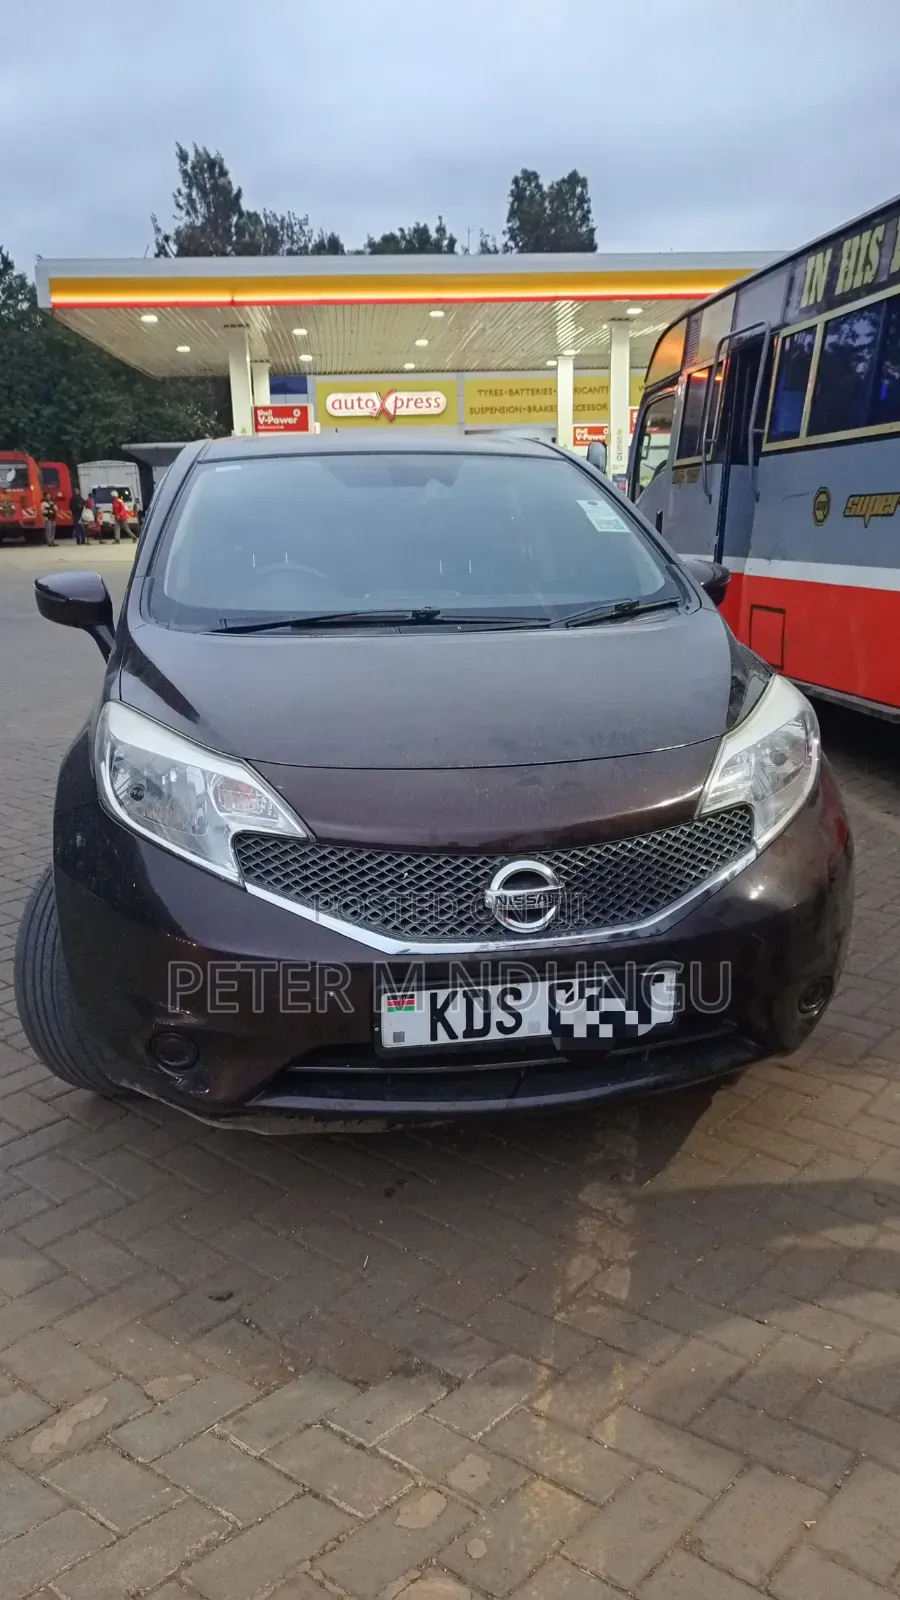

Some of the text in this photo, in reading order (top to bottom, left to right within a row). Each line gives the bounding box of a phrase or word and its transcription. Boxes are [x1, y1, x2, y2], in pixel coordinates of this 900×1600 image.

[800, 248, 833, 309] IN
[834, 223, 886, 296] HIS
[477, 389, 504, 397] TYRES
[508, 387, 553, 397] BATTERIES
[469, 405, 522, 415] SUSPENSION
[258, 416, 298, 425] V-Power
[496, 893, 557, 906] NISSAN
[429, 986, 523, 1042] KDS
